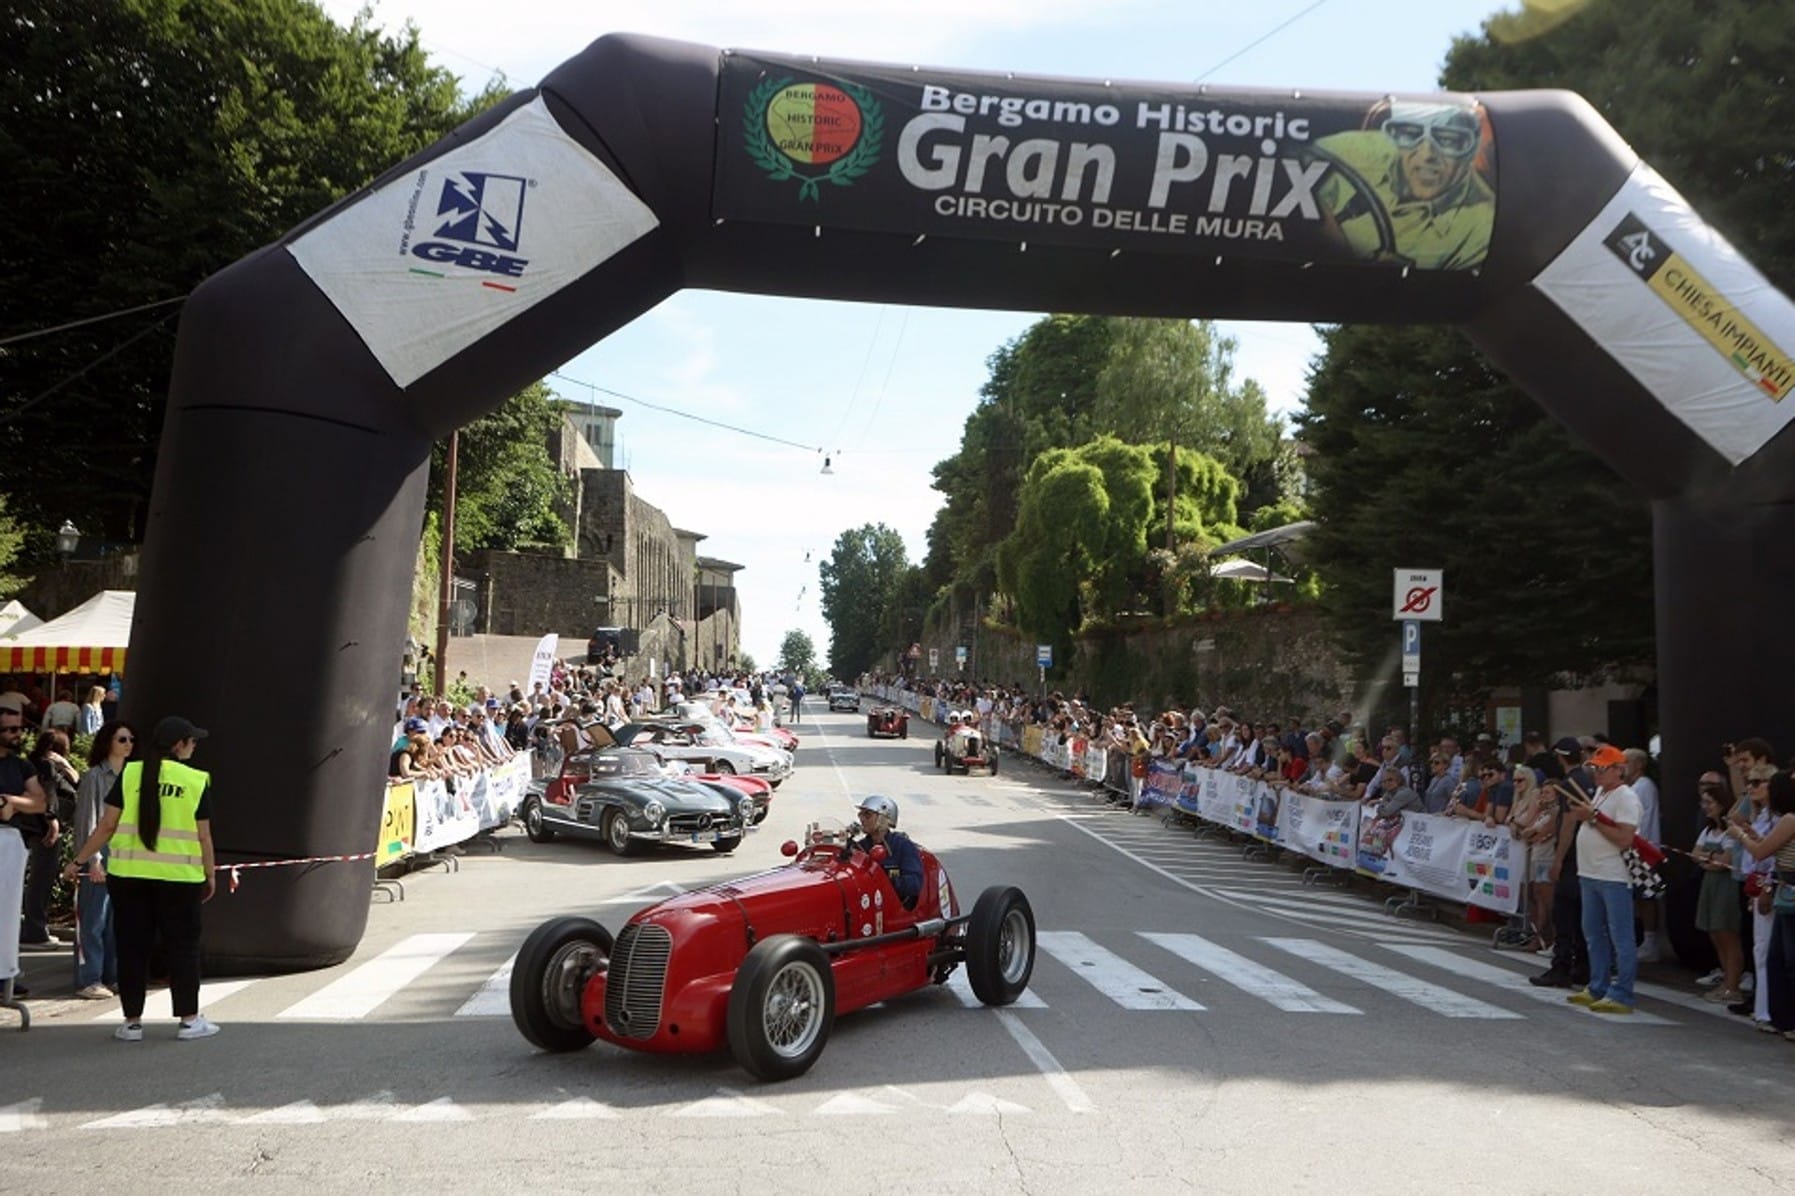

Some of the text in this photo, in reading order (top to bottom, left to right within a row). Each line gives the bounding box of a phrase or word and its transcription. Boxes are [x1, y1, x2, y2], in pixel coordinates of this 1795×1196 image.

[785, 90, 846, 102] BERGAMO
[921, 85, 1310, 140] Bergamo Historic
[787, 113, 841, 126] HISTORIC
[780, 138, 842, 154] GRAN PRIX
[897, 112, 1331, 220] Gran Prix
[934, 195, 1285, 241] CIRCUITO DELLE MURA
[411, 241, 529, 278] GBE
[1664, 268, 1792, 388] CHIESA IMPIANTI
[1406, 624, 1417, 652] P
